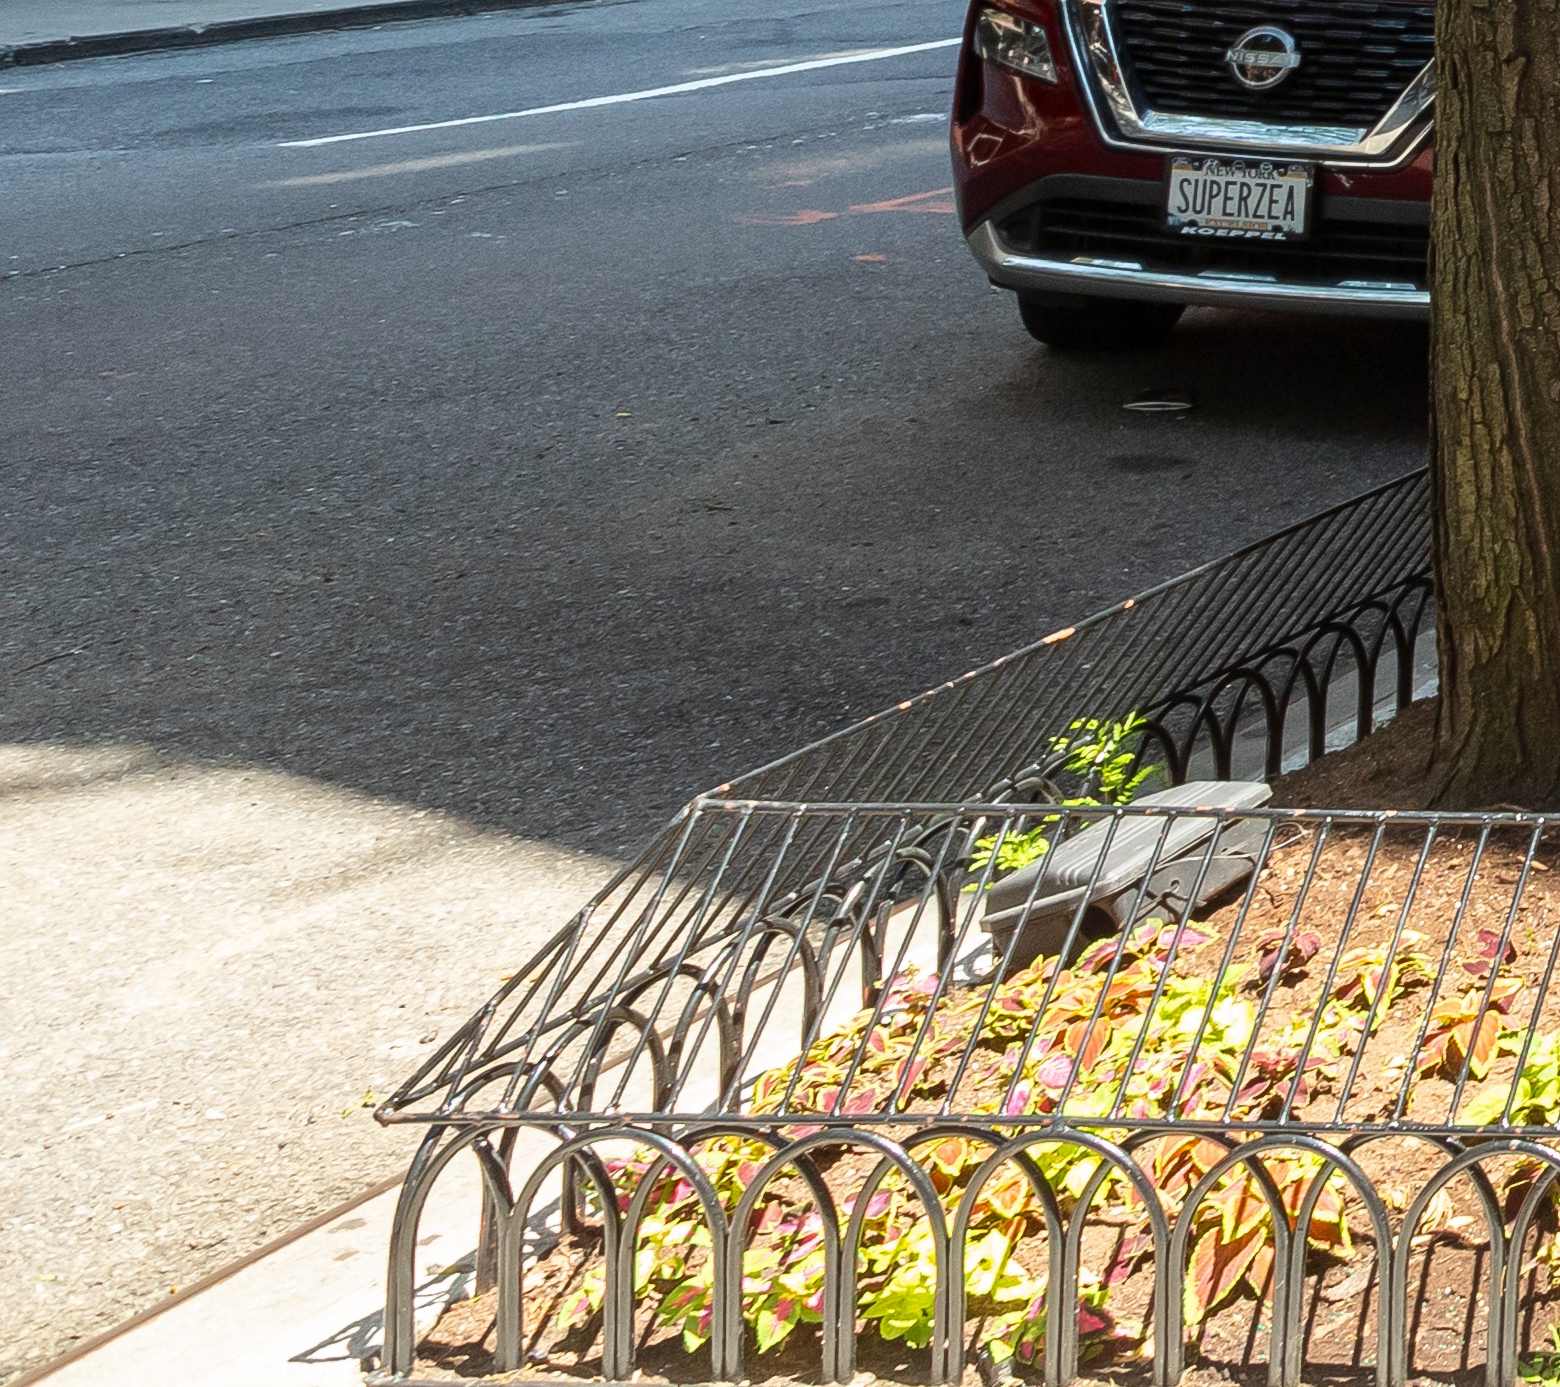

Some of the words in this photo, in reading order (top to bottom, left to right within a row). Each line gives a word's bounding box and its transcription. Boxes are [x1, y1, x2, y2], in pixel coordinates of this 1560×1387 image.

[1204, 164, 1235, 177] NEW
[1241, 167, 1278, 180] YORK
[1176, 177, 1296, 222] SUPERZEA
[1180, 226, 1287, 240] KOEPPEL
